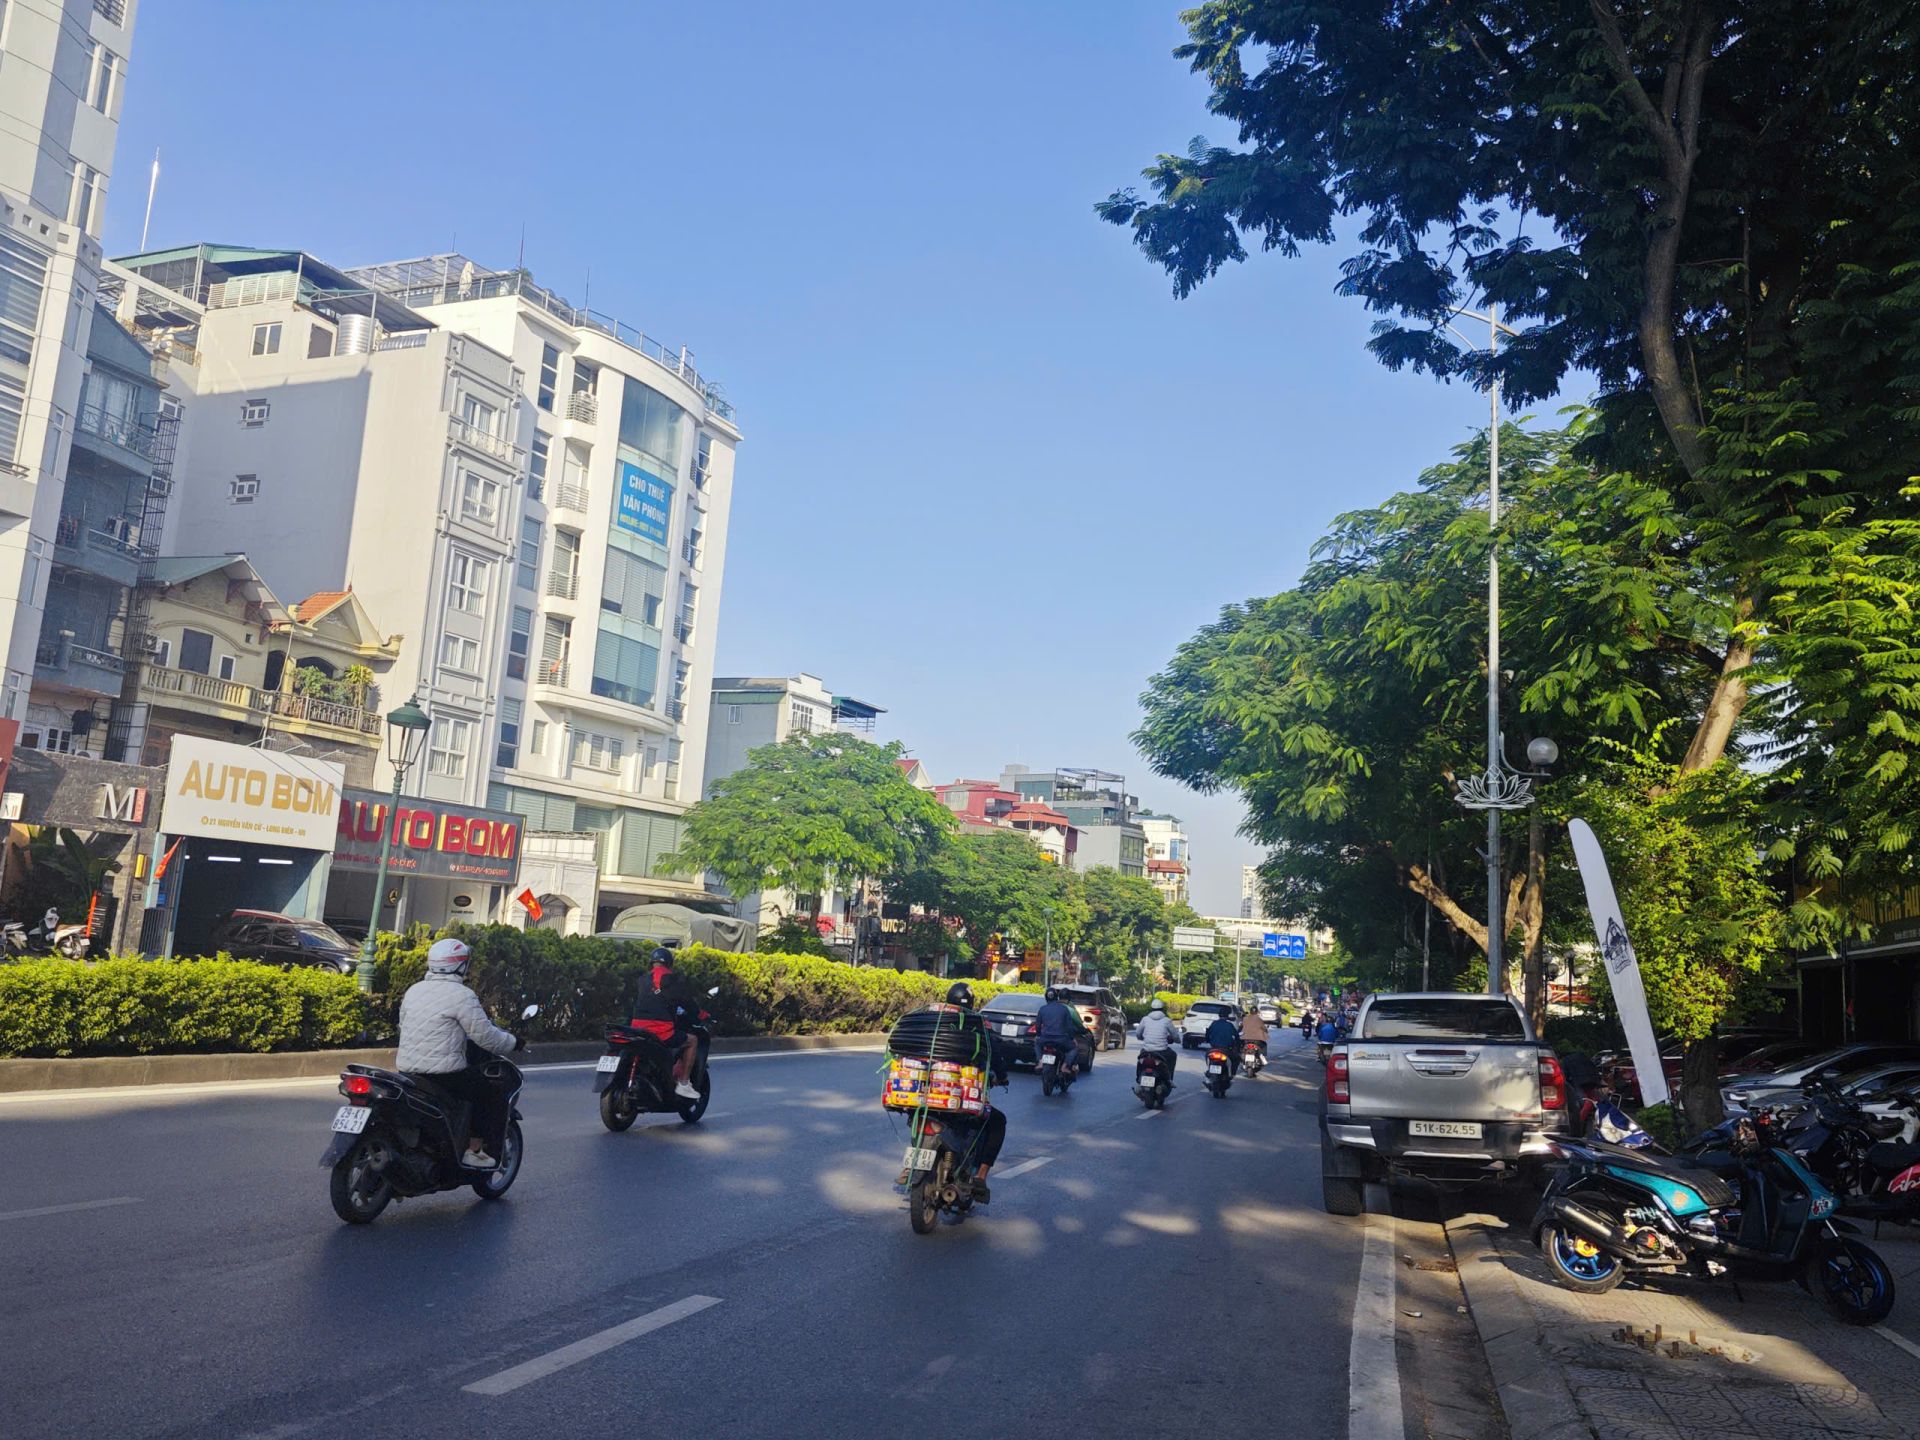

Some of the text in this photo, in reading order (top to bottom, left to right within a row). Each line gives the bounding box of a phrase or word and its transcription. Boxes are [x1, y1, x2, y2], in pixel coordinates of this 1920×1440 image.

[629, 474, 665, 503] CHO THUÊ
[623, 493, 667, 525] VĂN PHÒNG
[179, 759, 268, 807] AUTO
[271, 773, 335, 817] BOM
[338, 799, 518, 860] AUTO BOM
[1415, 1122, 1476, 1136] 51K-624.55
